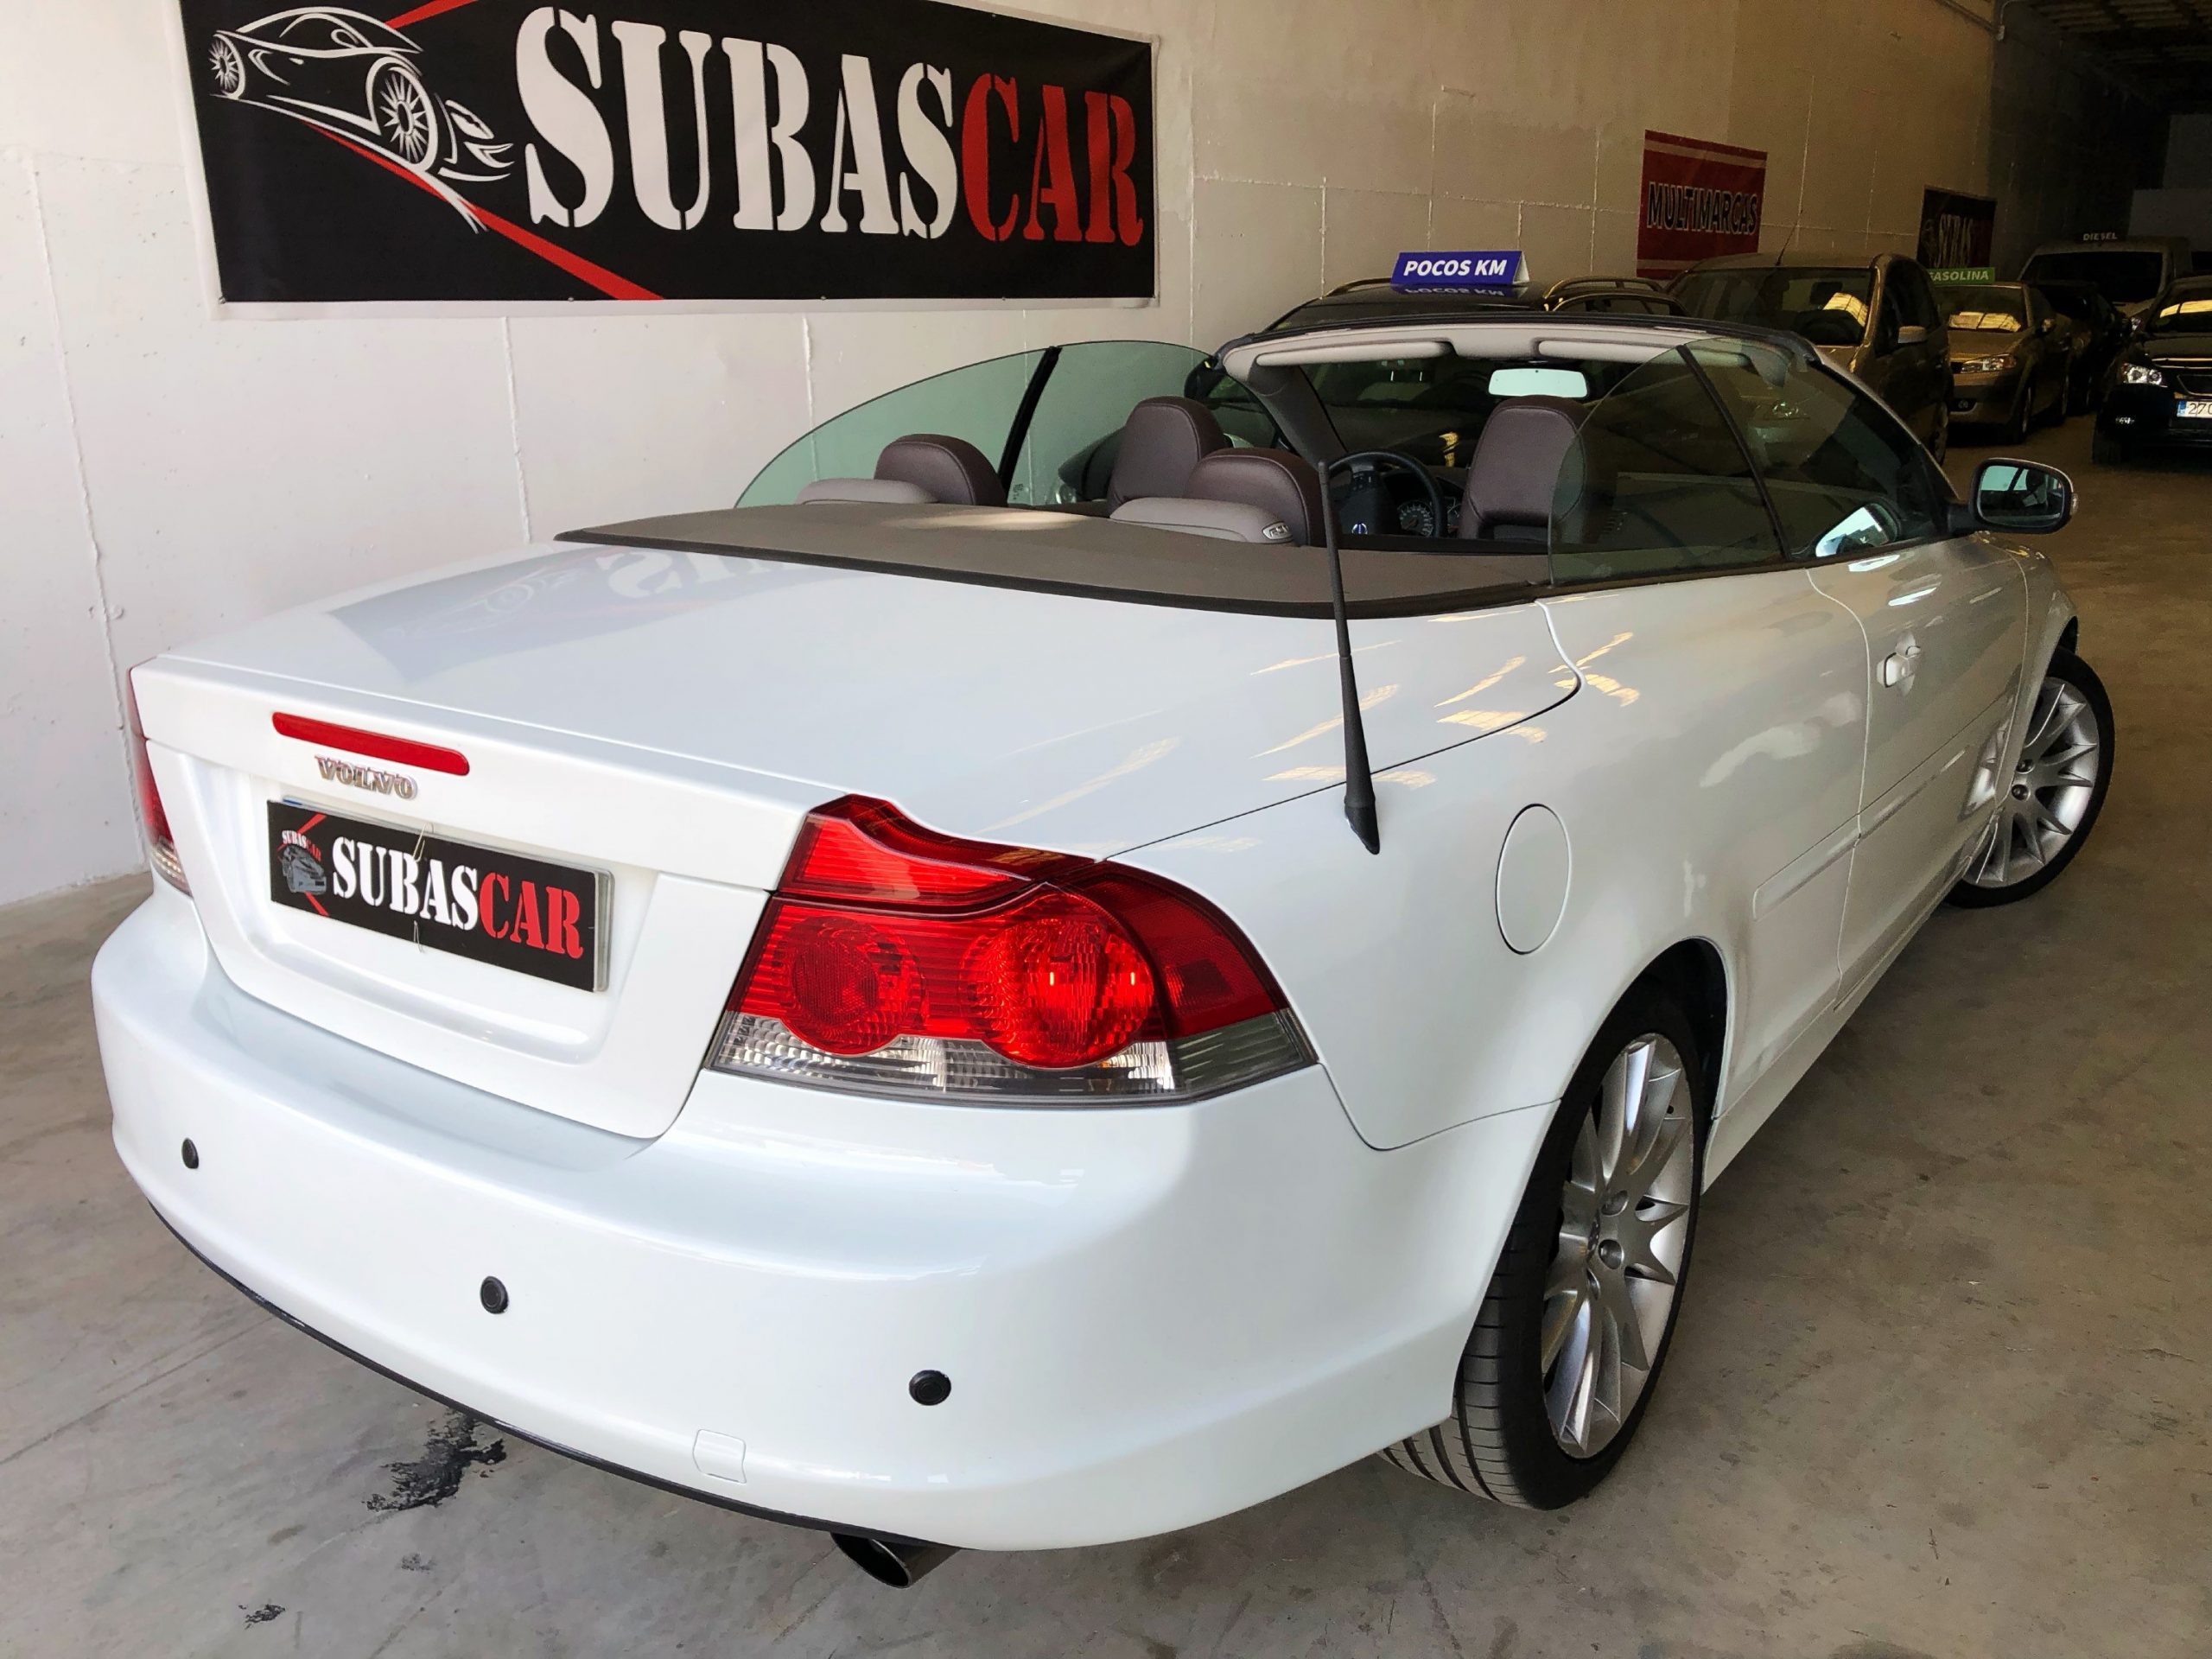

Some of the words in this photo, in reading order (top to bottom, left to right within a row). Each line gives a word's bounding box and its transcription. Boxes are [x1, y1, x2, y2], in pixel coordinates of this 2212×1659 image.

[514, 5, 1144, 247] SUBASCAR
[1646, 180, 1758, 236] MULTIMARCAS
[2082, 232, 2118, 241] DIESEL
[1403, 260, 1472, 276] POCOS
[1474, 259, 1508, 276] KM
[315, 754, 419, 800] VOLVO
[332, 836, 584, 959] SUBASCAR
